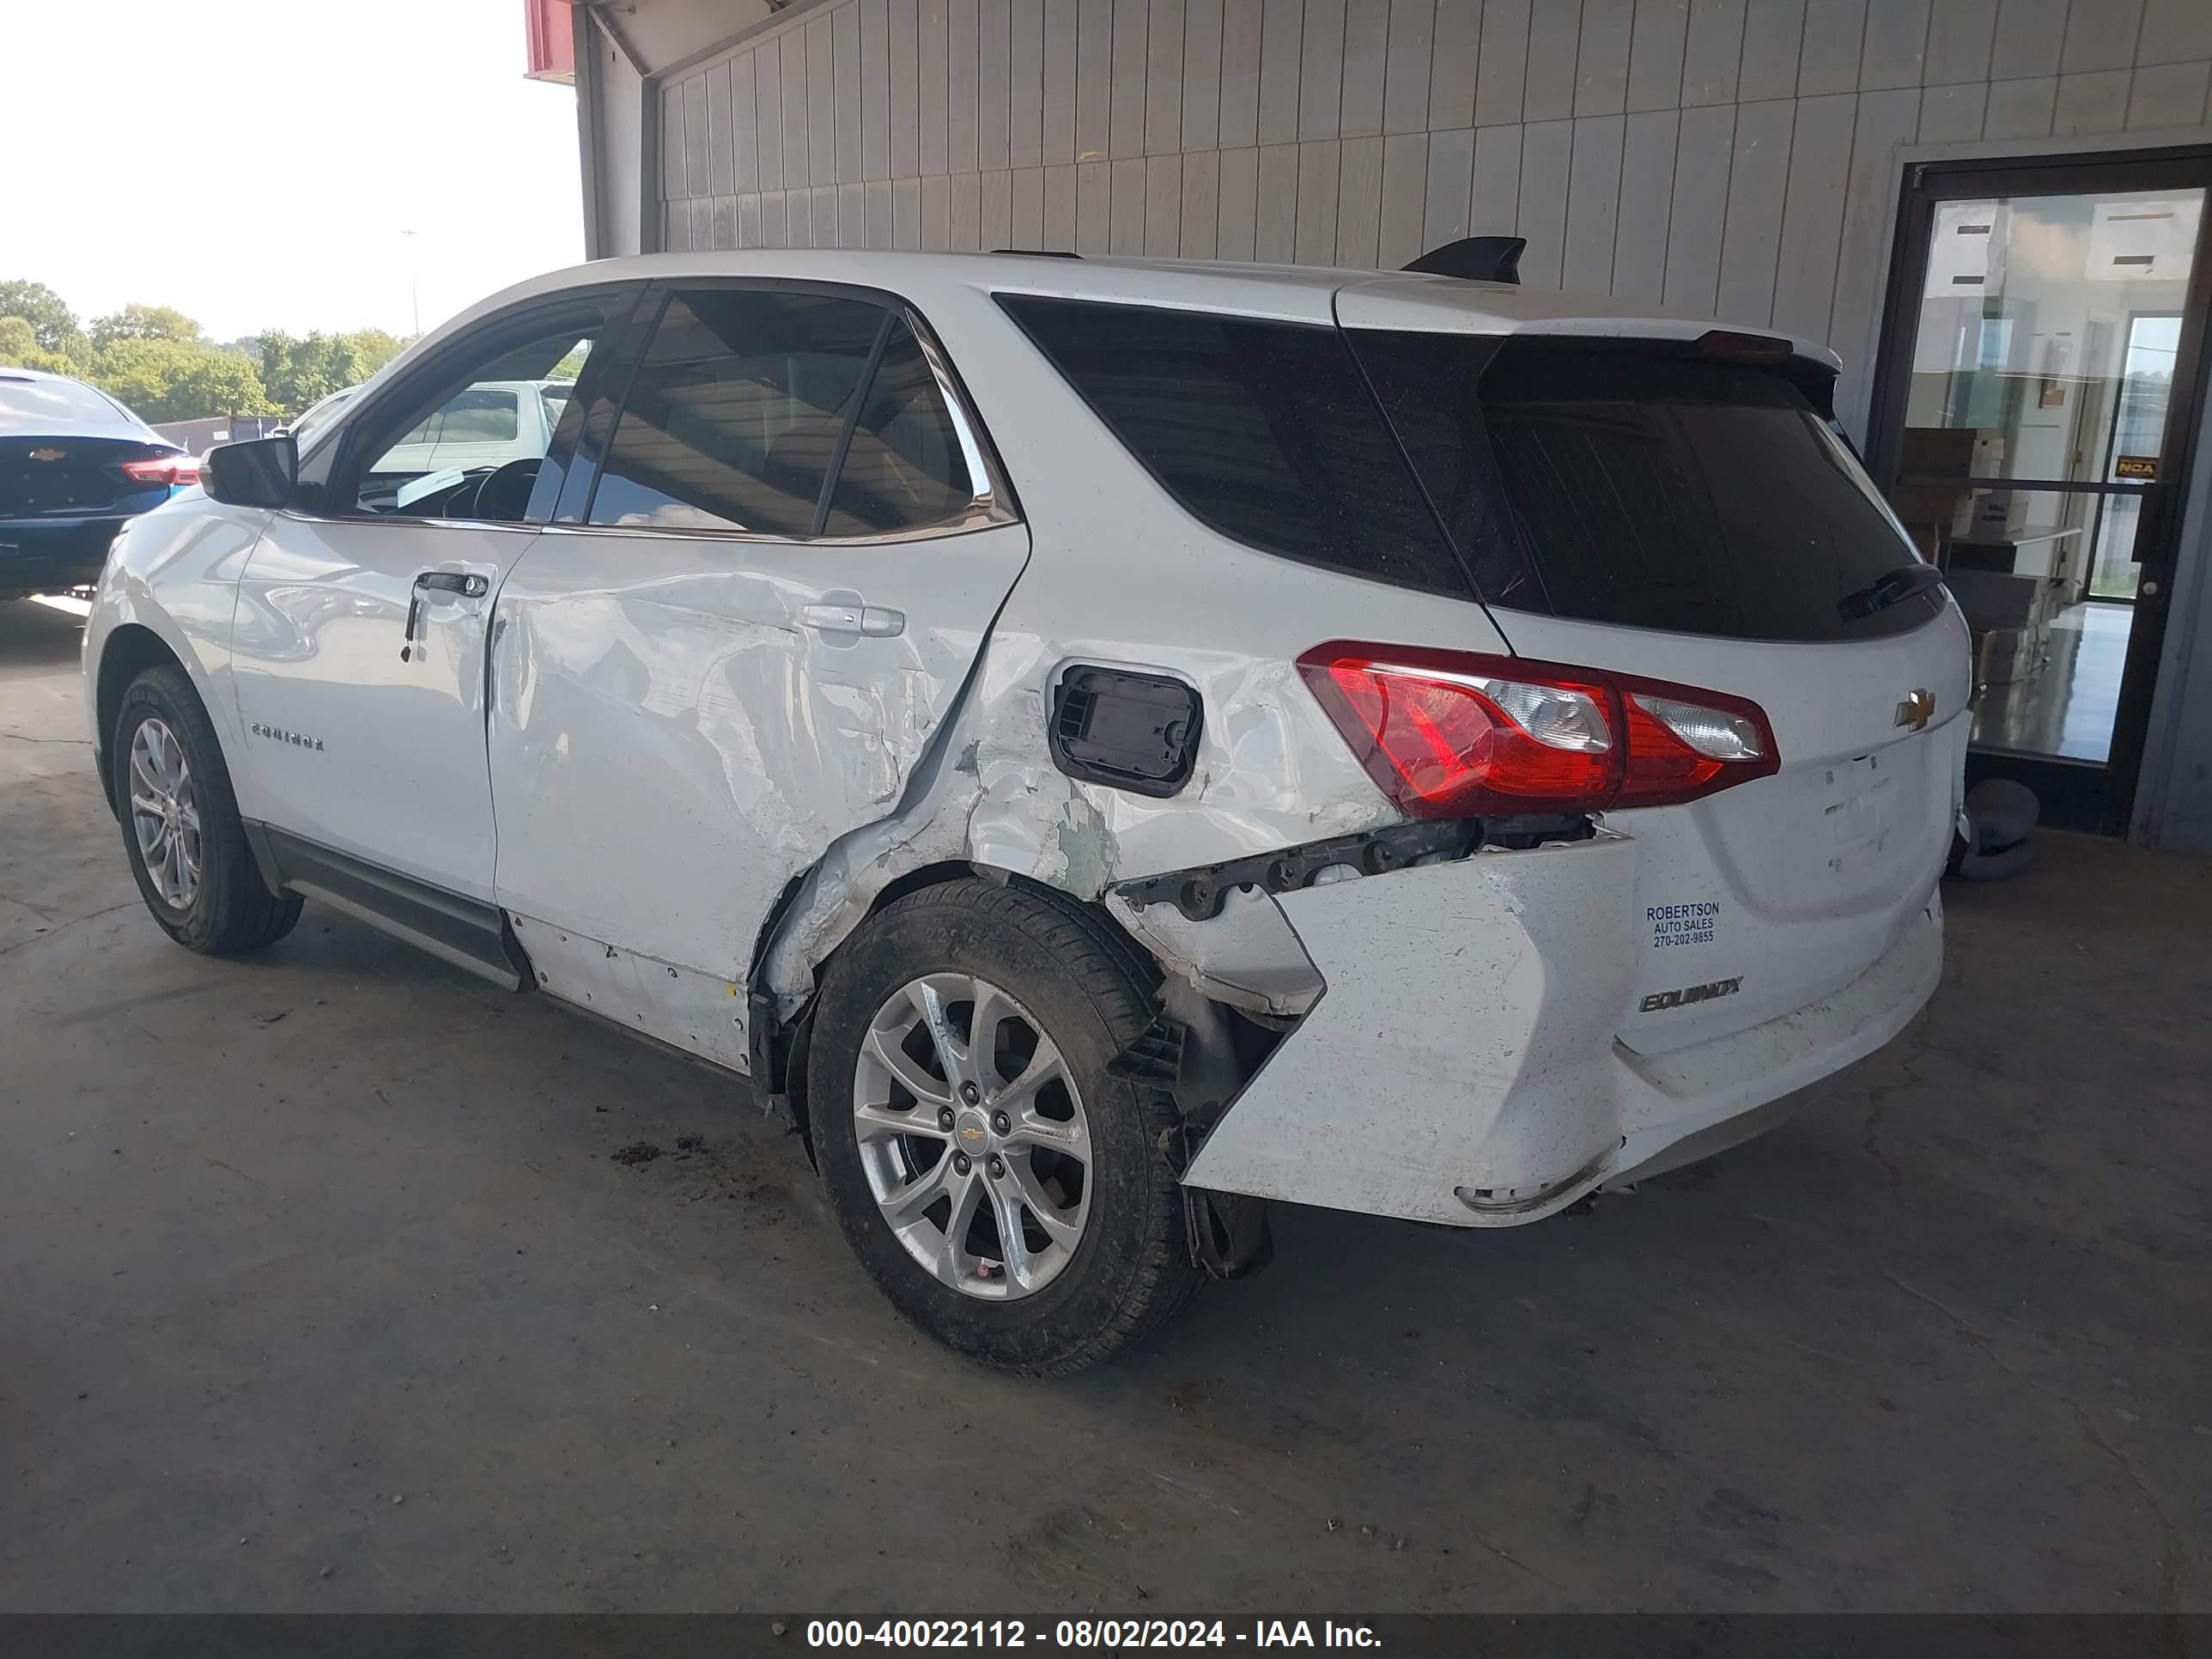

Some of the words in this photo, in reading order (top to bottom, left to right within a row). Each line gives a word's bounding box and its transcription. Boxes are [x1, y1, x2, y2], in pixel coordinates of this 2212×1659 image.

[251, 721, 325, 752] EQUINOX
[1646, 902, 1719, 921] ROBERTSON
[1654, 921, 1681, 934] AUTO
[1683, 918, 1714, 932] SALES
[1654, 931, 1714, 948] 270-202-9855
[1639, 976, 1744, 1013] EQUINOX
